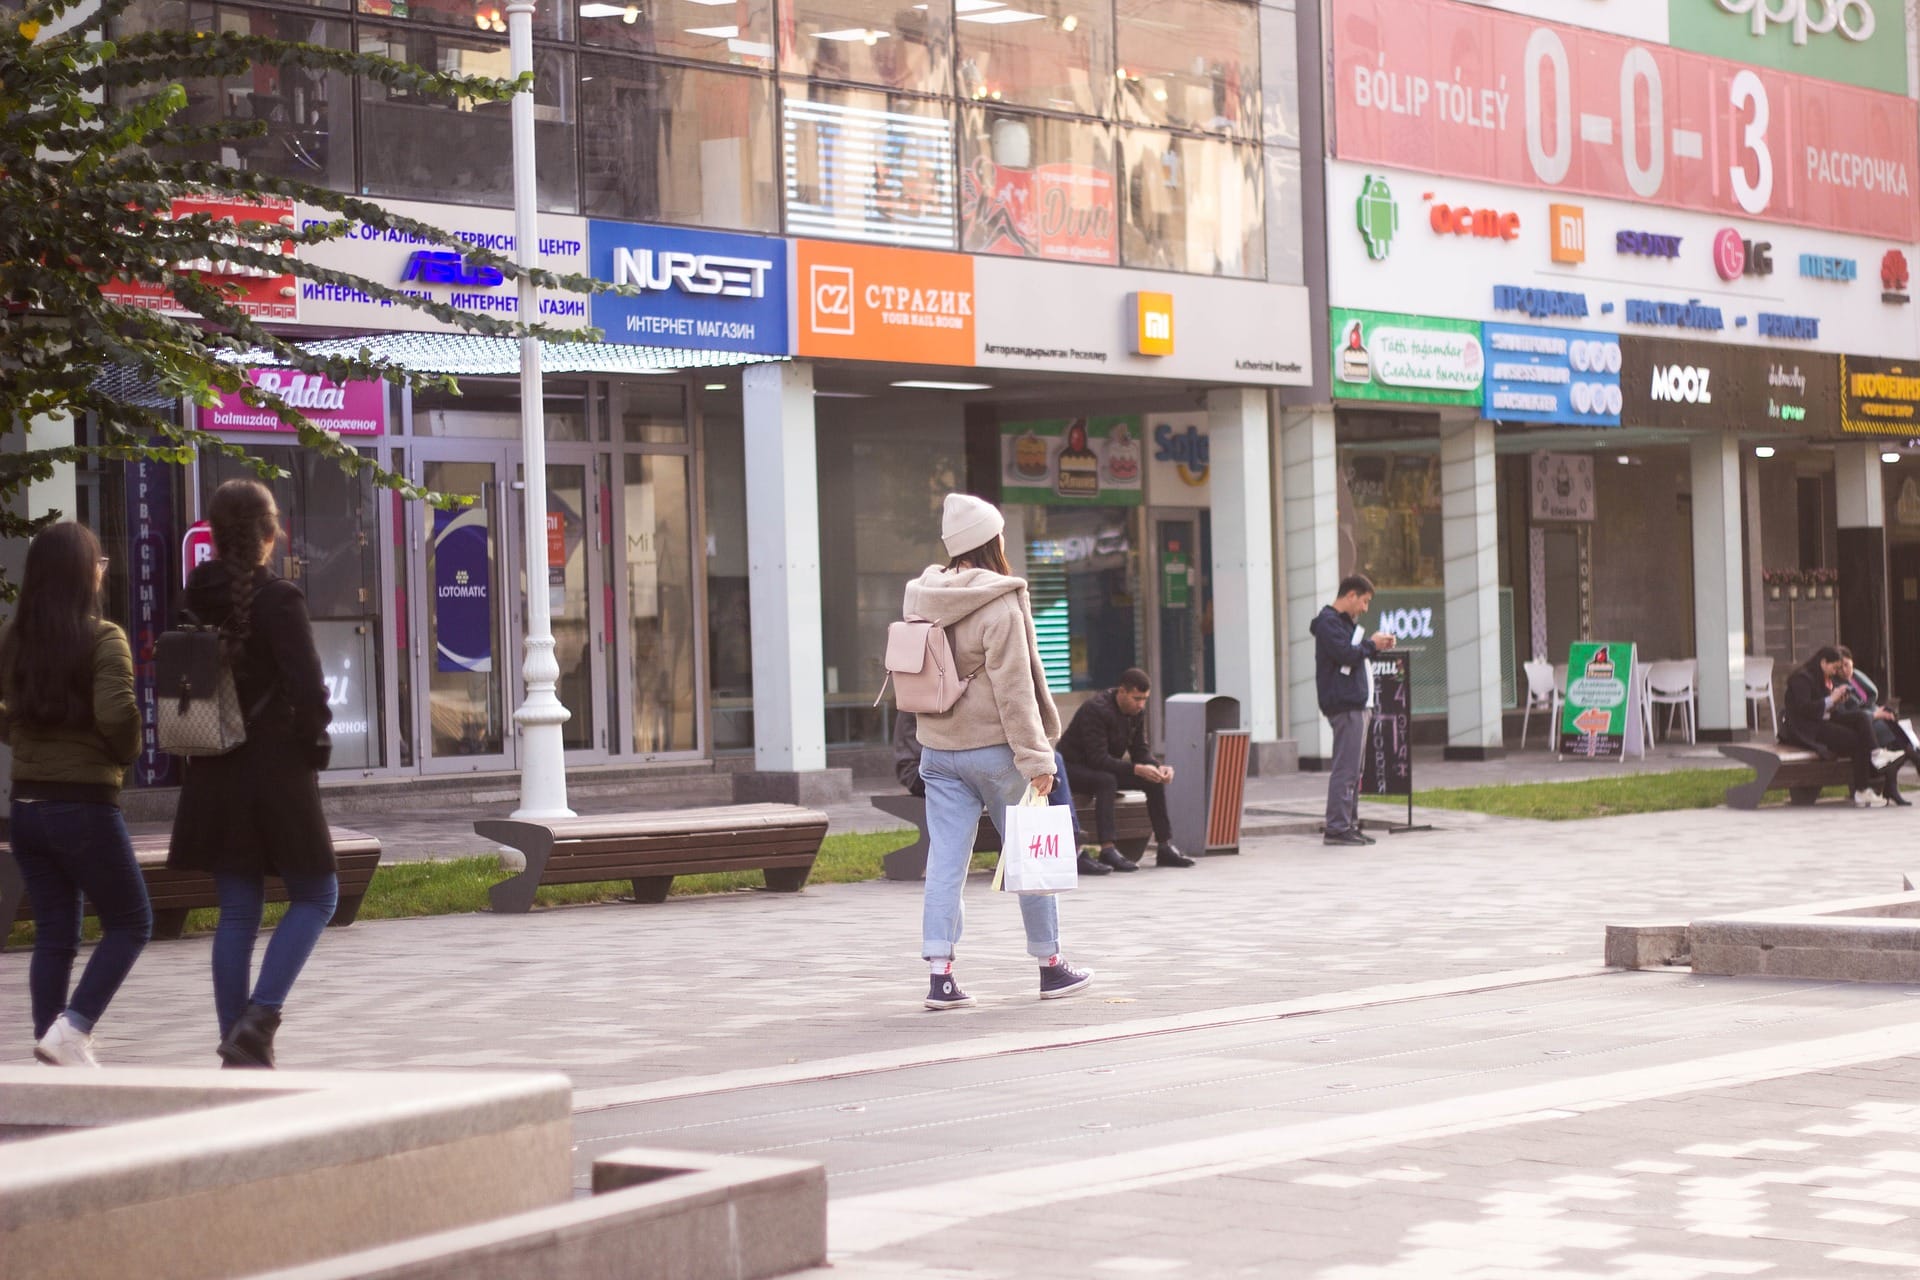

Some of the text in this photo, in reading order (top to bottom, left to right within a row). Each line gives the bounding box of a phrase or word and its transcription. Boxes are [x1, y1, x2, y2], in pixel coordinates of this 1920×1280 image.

[1715, 0, 1876, 45] ppo
[1355, 51, 1430, 117] BÓLIP
[1434, 66, 1509, 130] TÓLEÝ
[1806, 146, 1909, 197] РАССРОЧКА
[453, 231, 581, 257] ЕРВИСН ЦЕНТР
[1616, 230, 1683, 258] SONY
[401, 250, 504, 287] ASUS
[614, 247, 772, 298] NURSET
[451, 293, 519, 313] ИНТЕРНЕТ
[1493, 285, 1820, 340] ПРОДАЖА НАСТРОЙКА РЕМОНТ
[626, 314, 755, 340] ИНТЕРНЕТ МАГАЗИН
[1651, 364, 1711, 404] MOOZ
[213, 411, 278, 430] balmuzdaq
[438, 585, 487, 598] LOTOMATIC
[1379, 608, 1434, 640] MOOZ
[1371, 662, 1398, 676] enu
[1028, 834, 1059, 859] H&M
